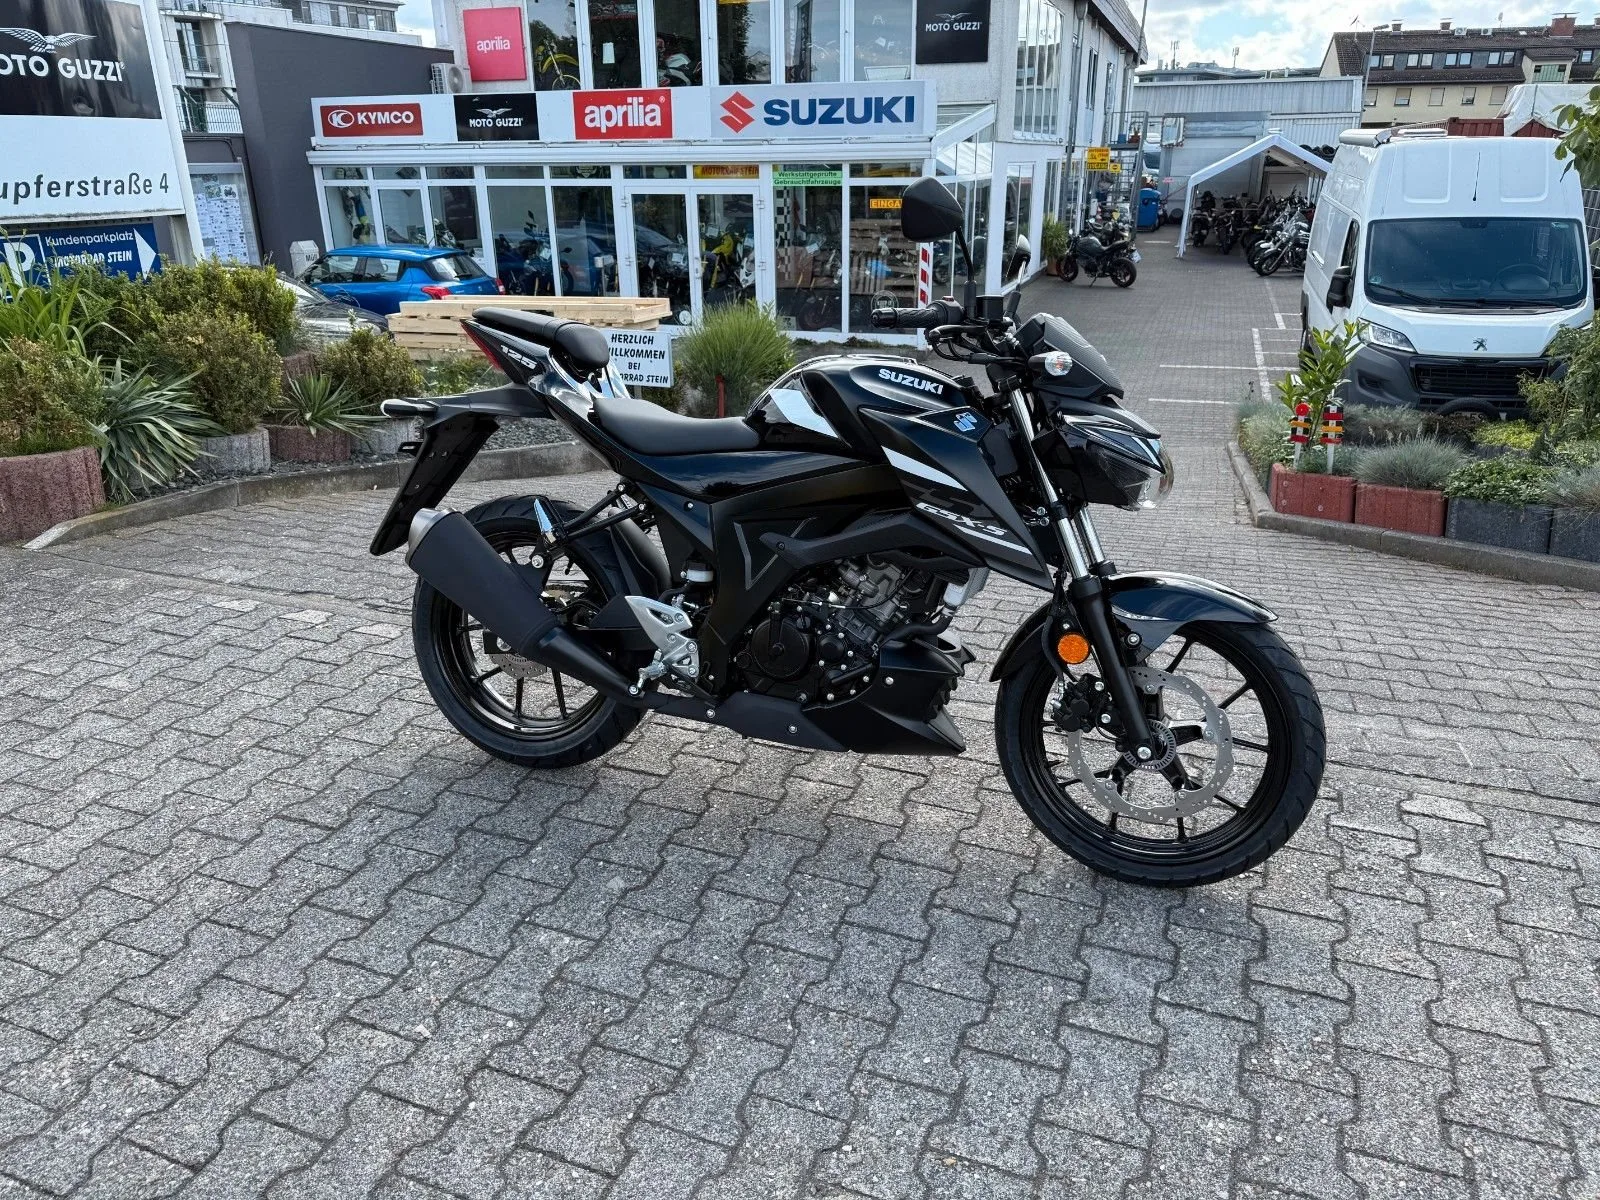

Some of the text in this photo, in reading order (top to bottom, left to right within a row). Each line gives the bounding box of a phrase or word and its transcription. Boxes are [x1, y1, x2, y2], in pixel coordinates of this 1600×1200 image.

[925, 22, 980, 32] MOTO GUZZI
[477, 36, 511, 53] aprilia
[0, 53, 122, 82] OTO GUZZI
[584, 96, 662, 133] aprilia
[763, 95, 915, 126] SUZUKI
[357, 111, 414, 125] KYMCO
[469, 117, 522, 128] MOTO GUZZI
[774, 178, 841, 186] Gebrauchtfahrzeuge
[778, 171, 837, 179] Werkstattgeprüfte
[0, 172, 169, 205] upferstraße 4
[871, 200, 902, 208] EINGA
[45, 230, 134, 247] Kundenparkplatz
[107, 249, 133, 263] STEIN
[611, 333, 655, 345] HERZLICH
[500, 344, 538, 370] 125
[628, 362, 640, 371] BEI
[620, 373, 668, 384] ORRAD STEIN
[878, 368, 944, 395] SUZUKI
[915, 502, 1008, 536] GSX-S
